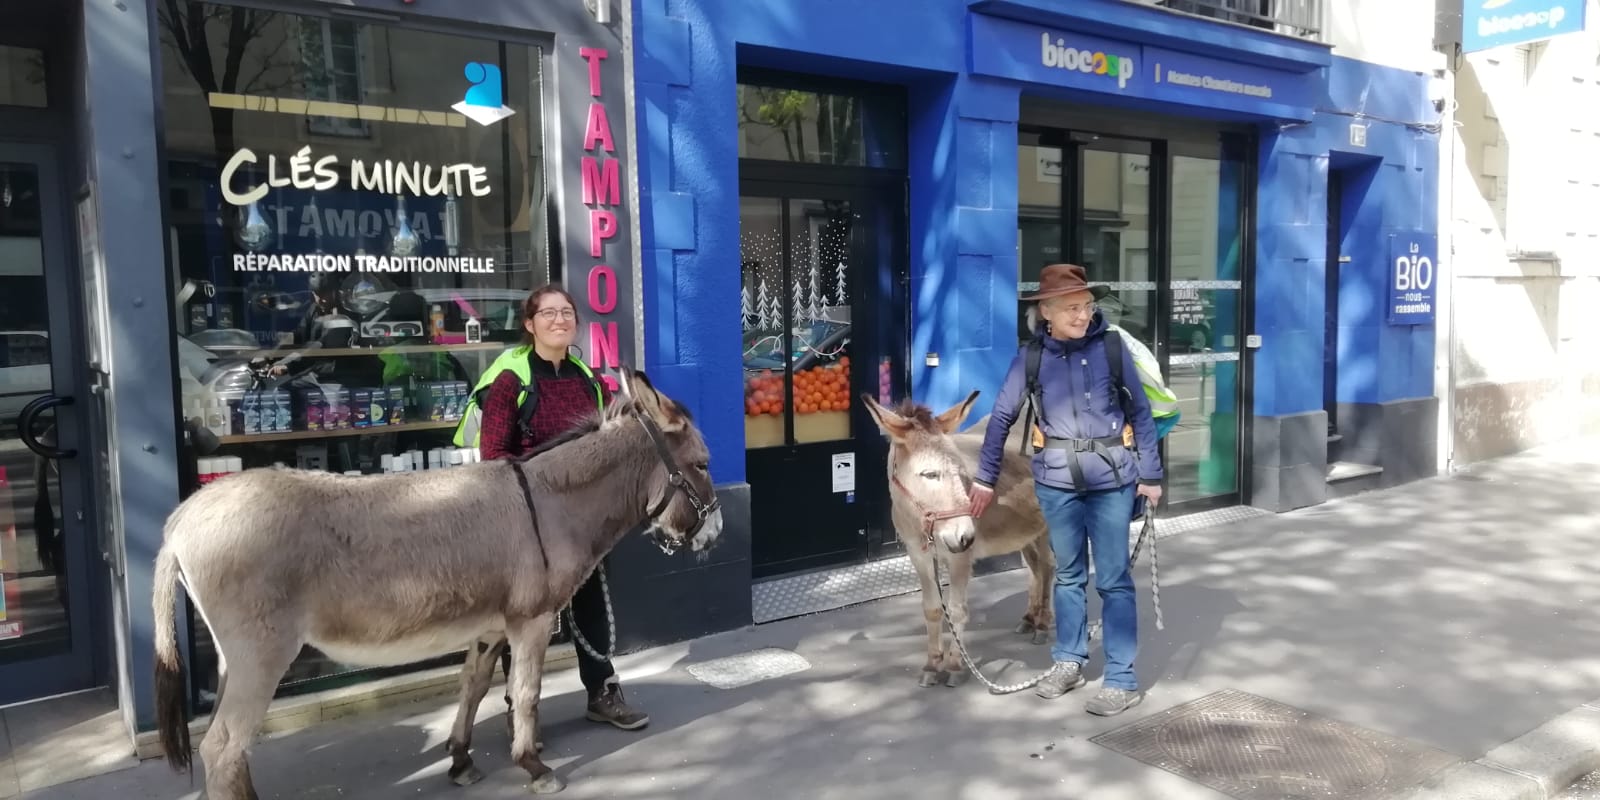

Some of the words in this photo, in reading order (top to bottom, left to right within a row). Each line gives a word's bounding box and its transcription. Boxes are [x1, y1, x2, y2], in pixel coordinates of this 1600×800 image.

[1478, 6, 1565, 37] biocoop
[1042, 32, 1133, 89] biocoop
[220, 145, 339, 206] CLÉS
[351, 159, 491, 197] MINUTE
[1409, 242, 1419, 253] La
[233, 252, 350, 272] RÉPARATION
[355, 255, 494, 273] TRADITIONNELLE
[1405, 293, 1422, 301] nous
[1395, 303, 1431, 314] rassemble
